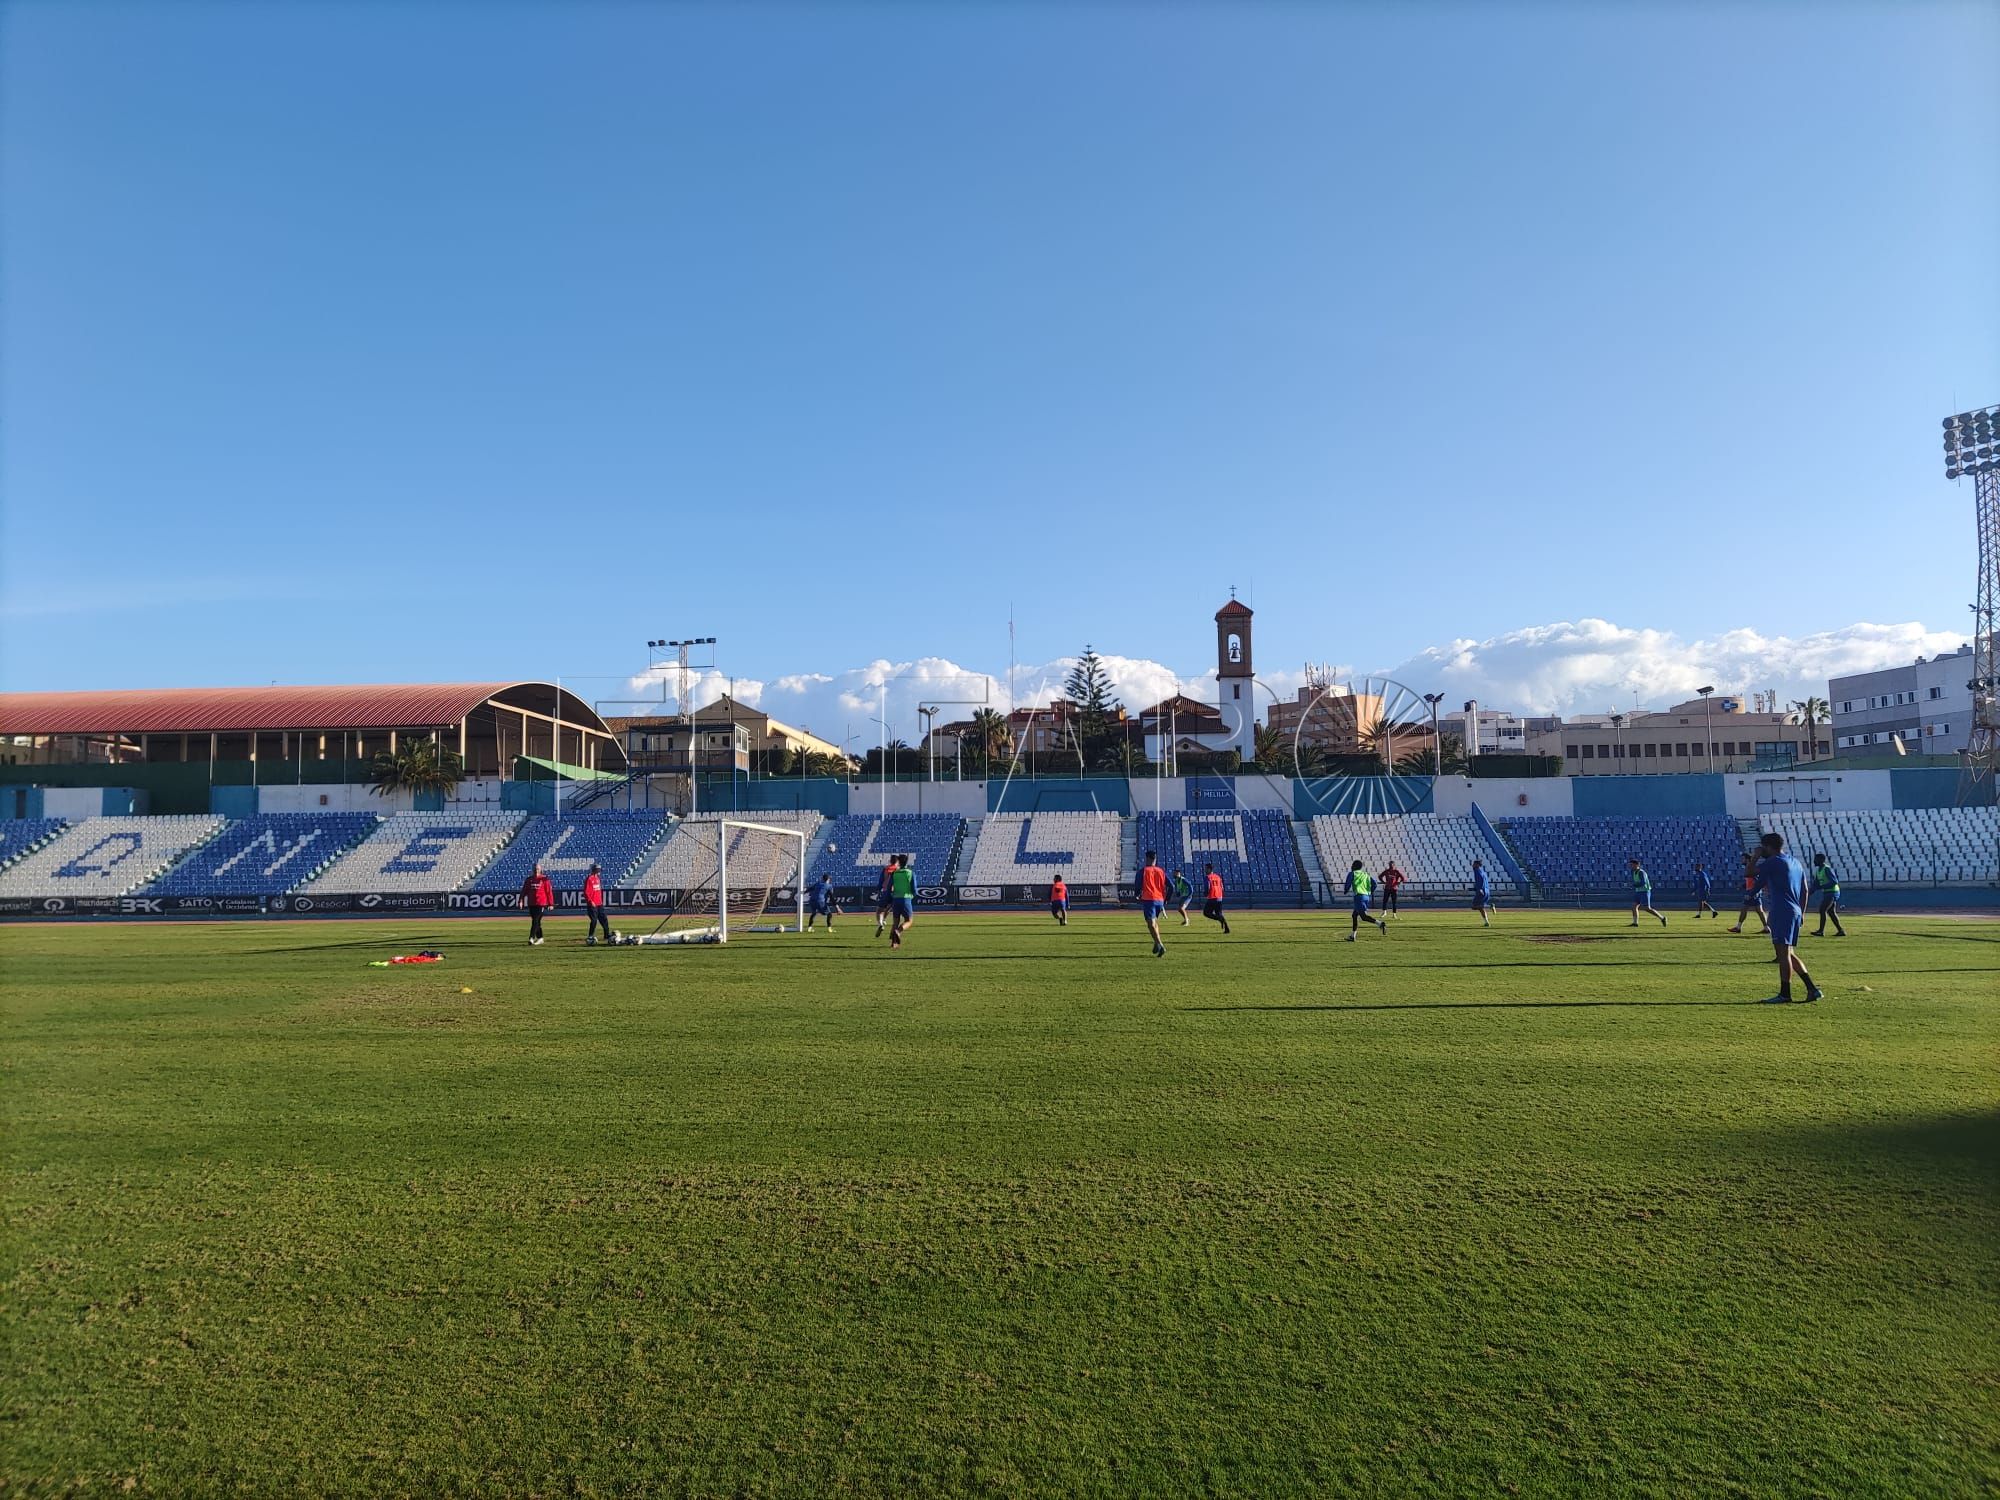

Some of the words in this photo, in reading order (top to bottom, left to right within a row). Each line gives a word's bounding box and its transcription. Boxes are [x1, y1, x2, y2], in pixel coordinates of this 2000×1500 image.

[562, 891, 646, 906] MEILLA
[962, 889, 999, 898] CRD
[121, 898, 163, 913] BRK
[178, 899, 213, 908] SAITO
